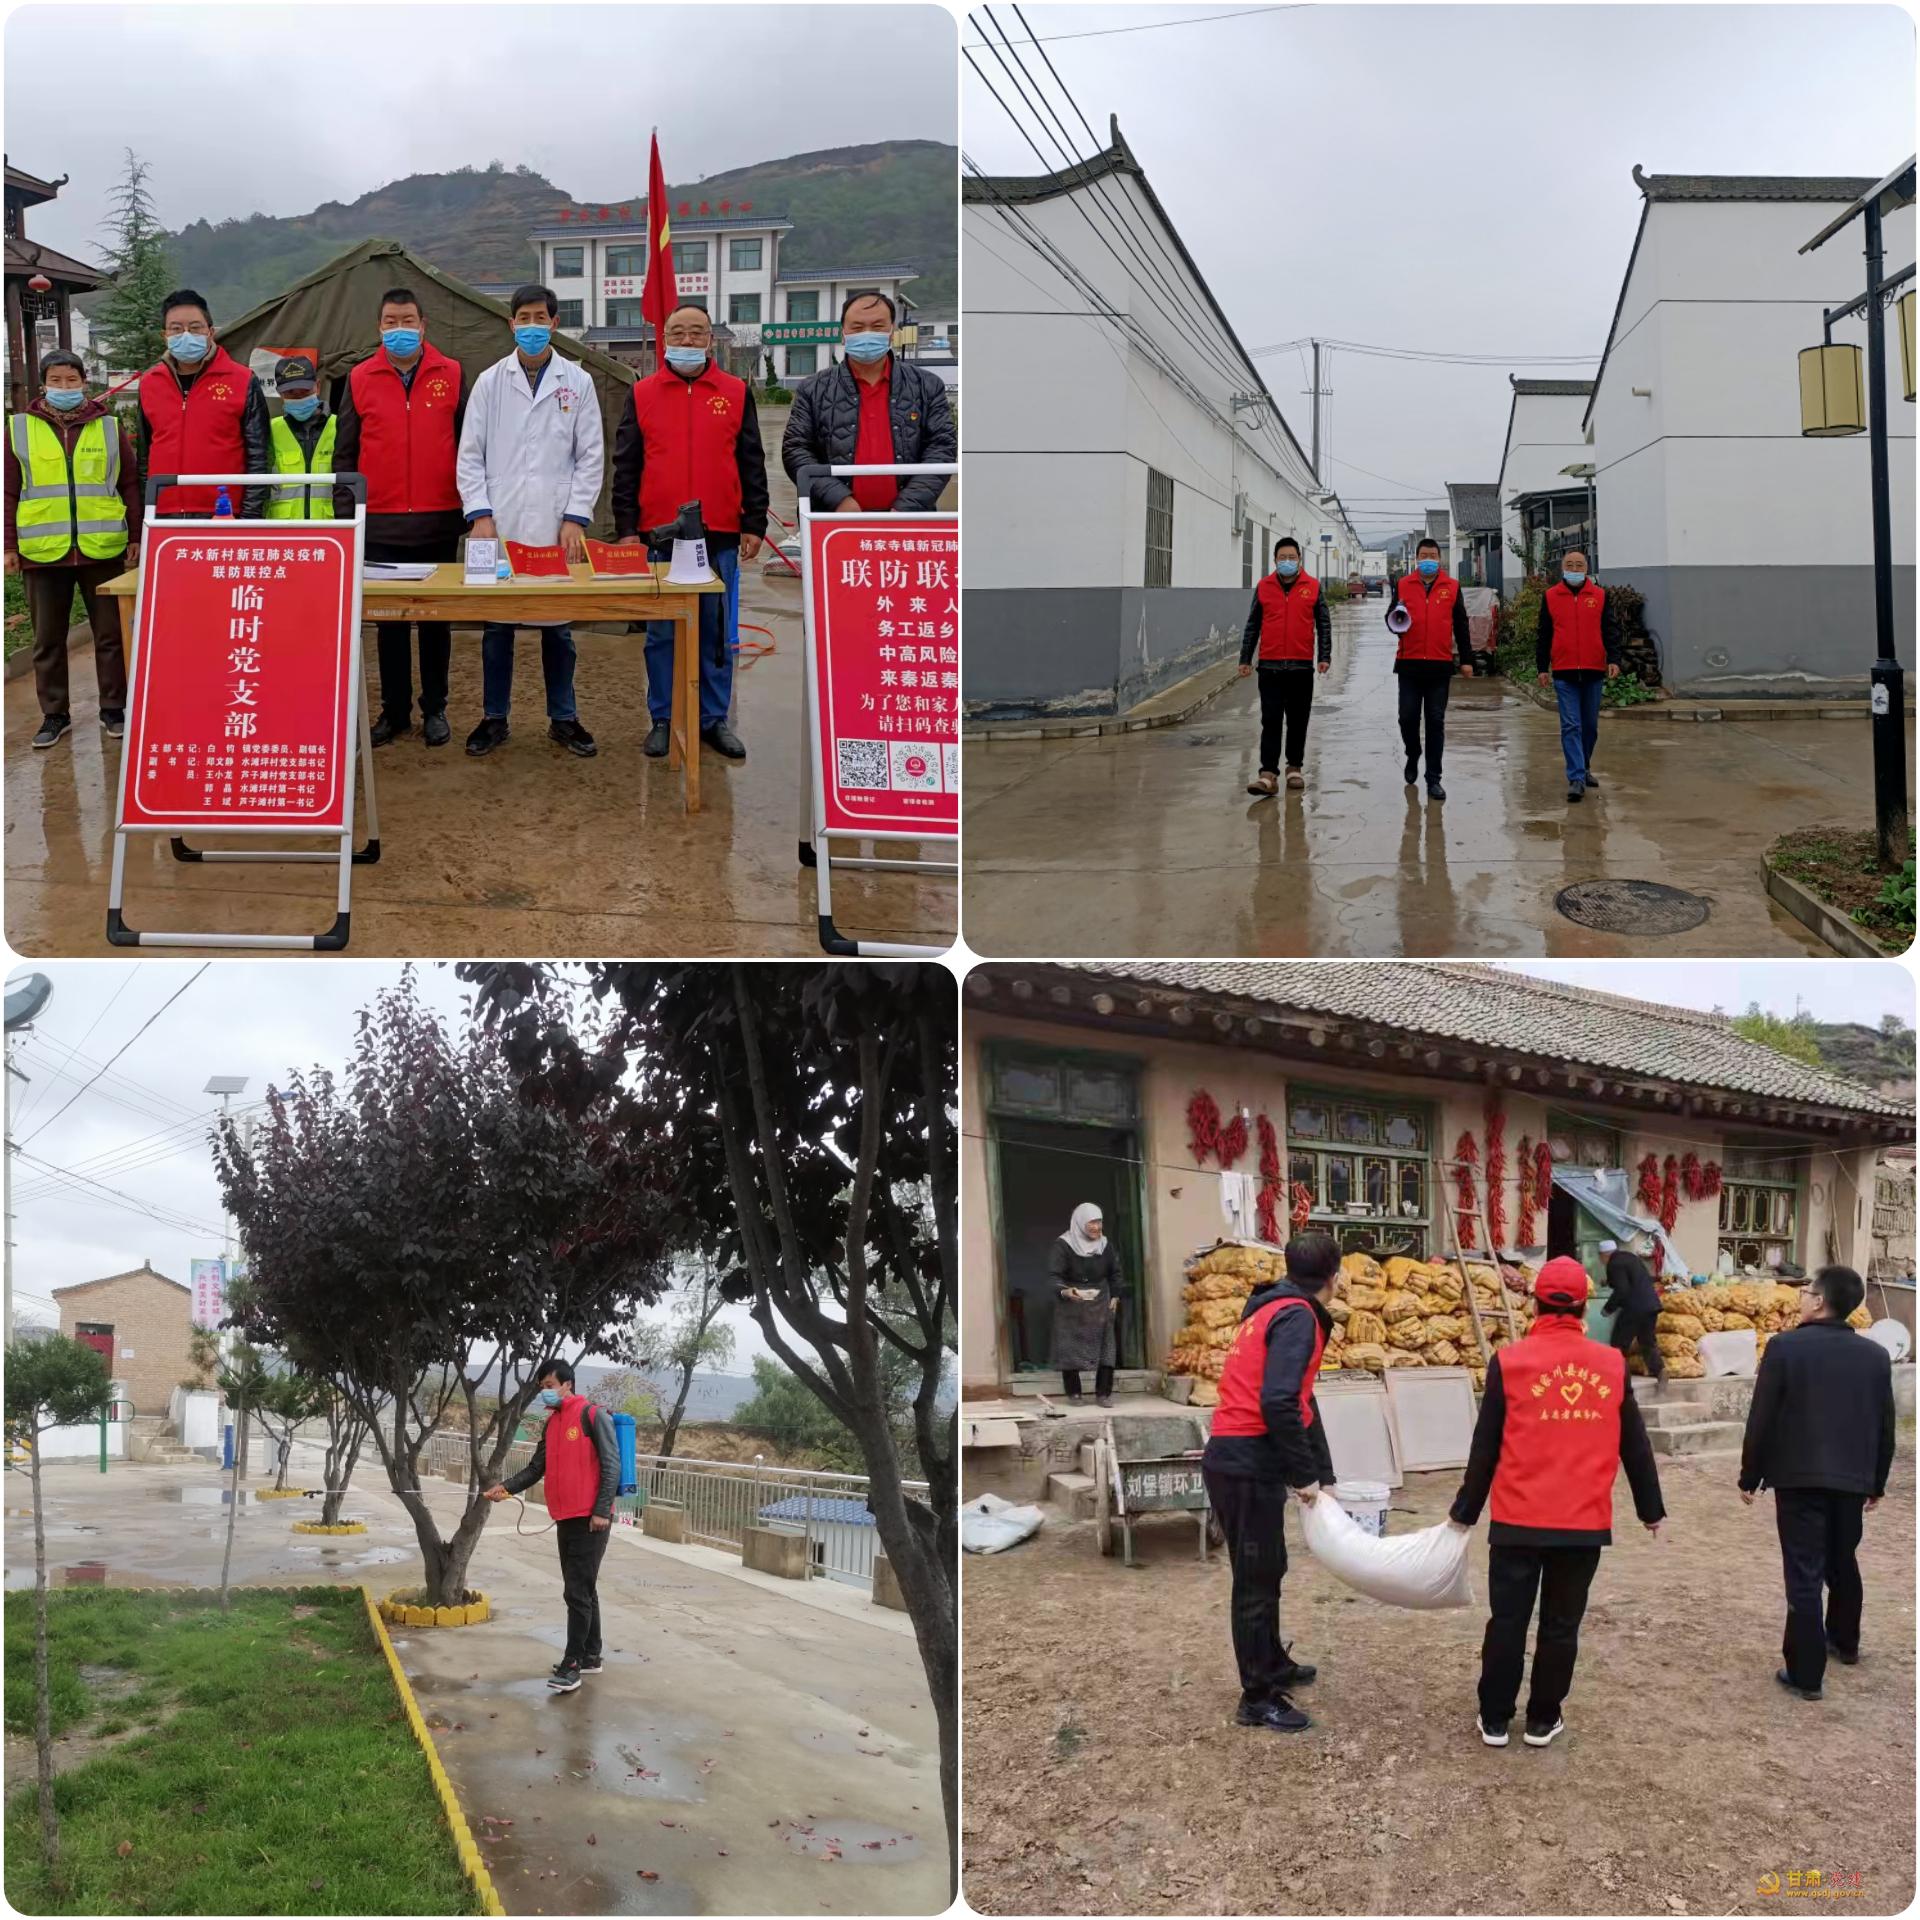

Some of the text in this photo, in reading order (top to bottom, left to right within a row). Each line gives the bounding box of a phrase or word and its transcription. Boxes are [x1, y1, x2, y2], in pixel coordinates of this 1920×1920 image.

[176, 548, 326, 562] 芦水新村新冠肺炎疫情
[212, 566, 287, 579] 联防联控点
[841, 559, 958, 590] 联防联
[878, 620, 954, 638] 务工返乡
[224, 584, 265, 739] 临时党支部
[879, 645, 958, 664] 中高风险
[880, 670, 958, 688] 来秦返秦
